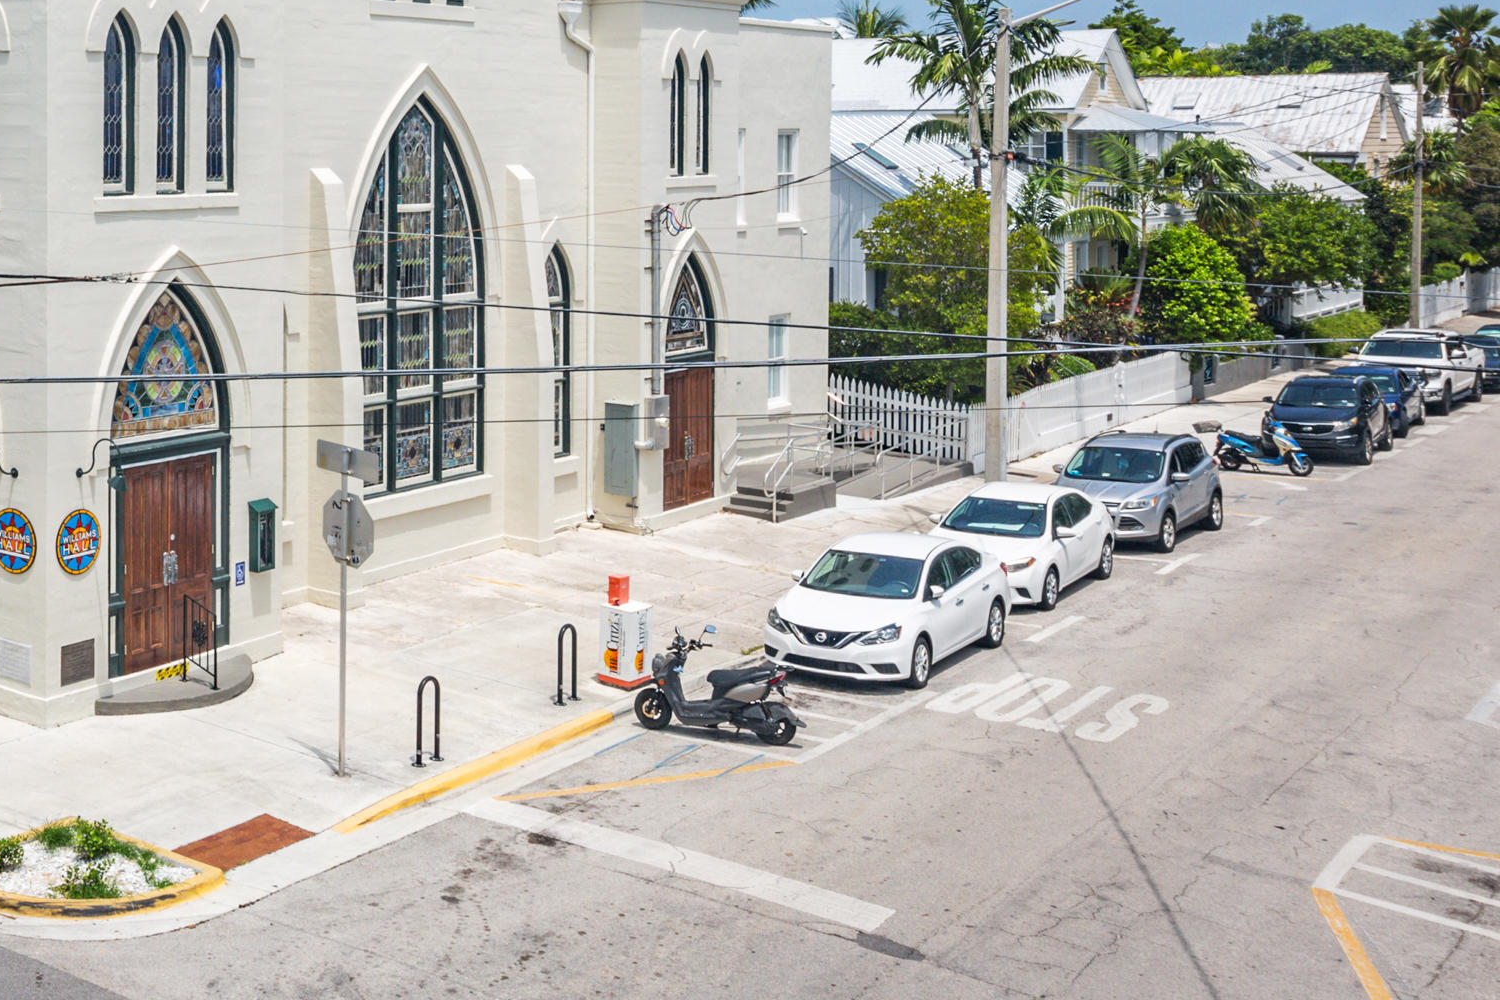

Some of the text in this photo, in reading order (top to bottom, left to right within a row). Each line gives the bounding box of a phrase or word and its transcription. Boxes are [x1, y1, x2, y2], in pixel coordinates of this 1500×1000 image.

[62, 529, 97, 545] WILLIAMS
[62, 538, 97, 556] HALL
[924, 672, 1170, 743] STOP
